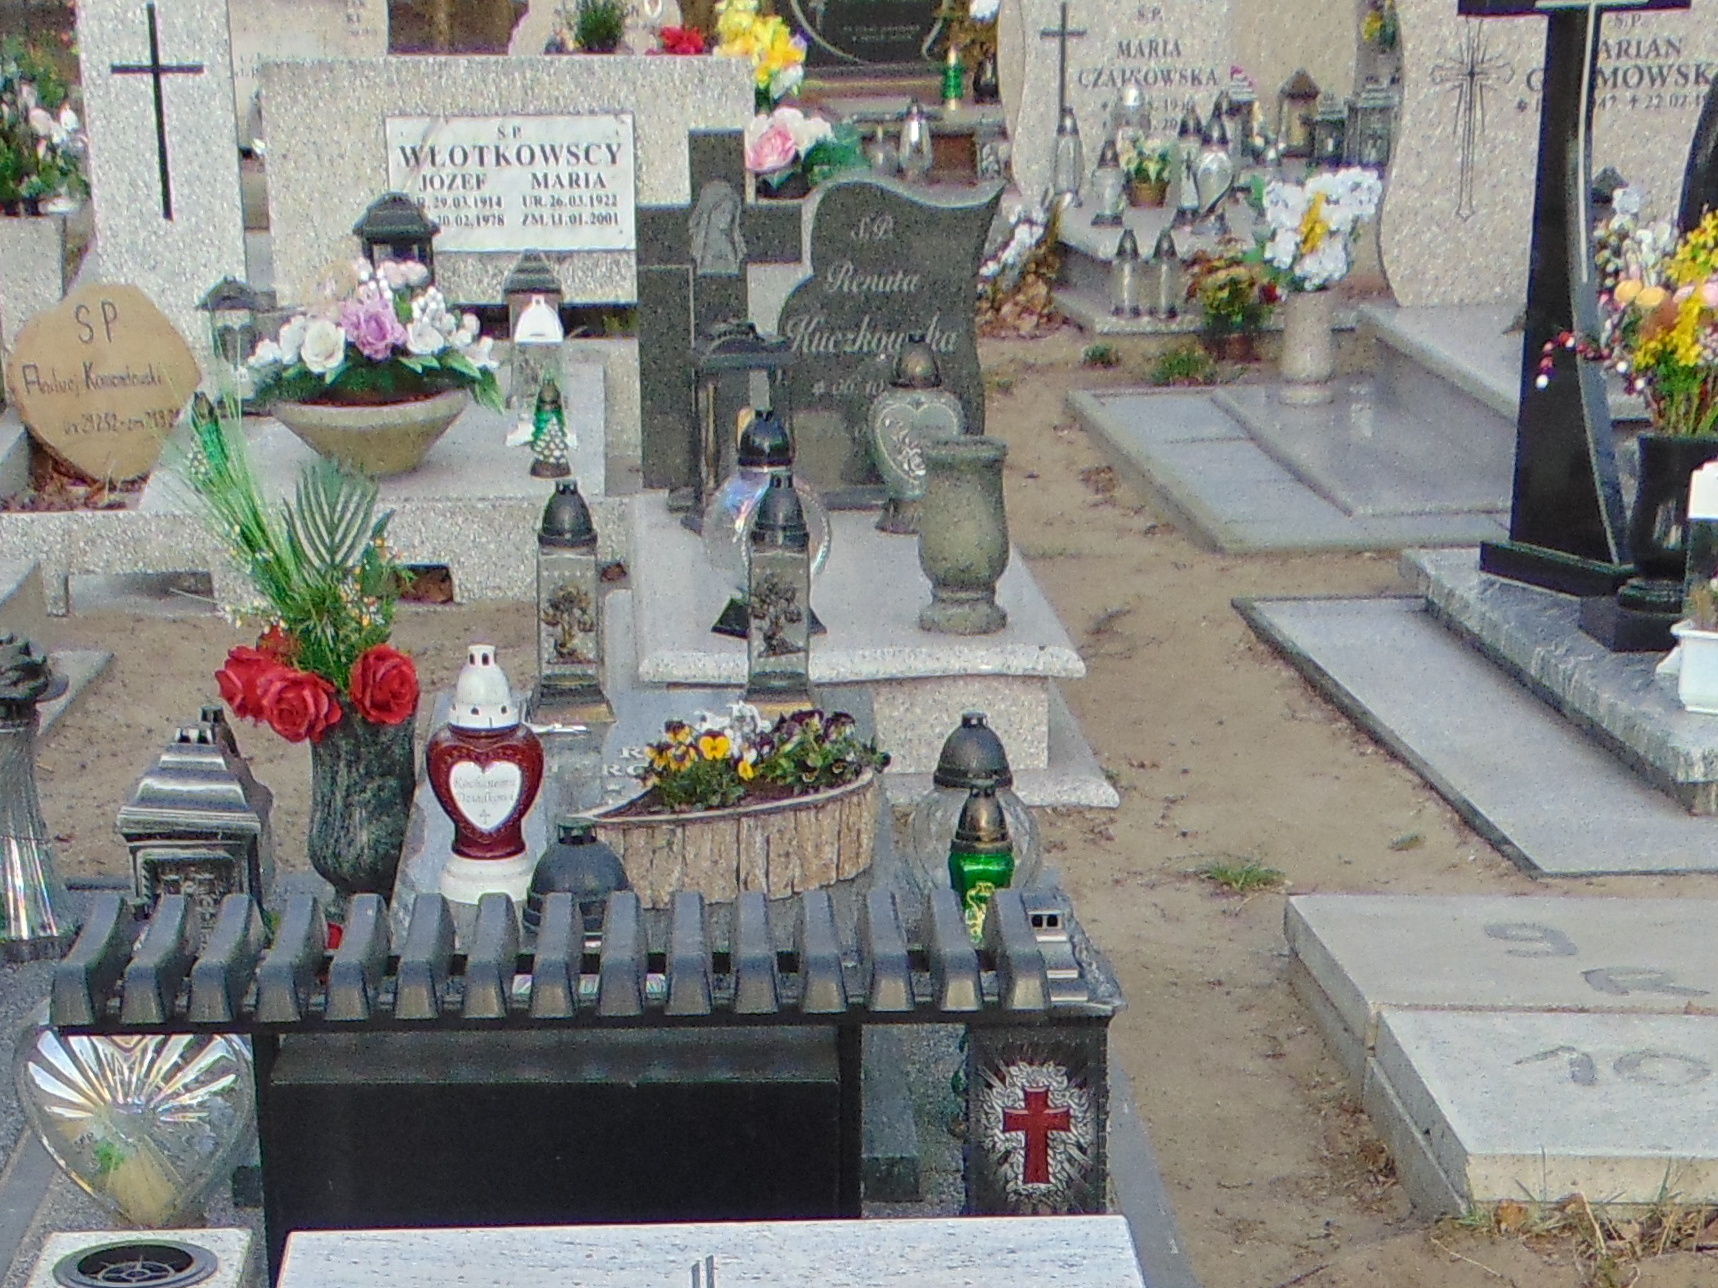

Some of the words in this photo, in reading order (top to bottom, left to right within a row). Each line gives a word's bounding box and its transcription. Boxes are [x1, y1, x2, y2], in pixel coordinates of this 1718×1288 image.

[1117, 39, 1182, 58] MARIA
[531, 171, 608, 191] MARIA
[828, 259, 922, 293] Renata
